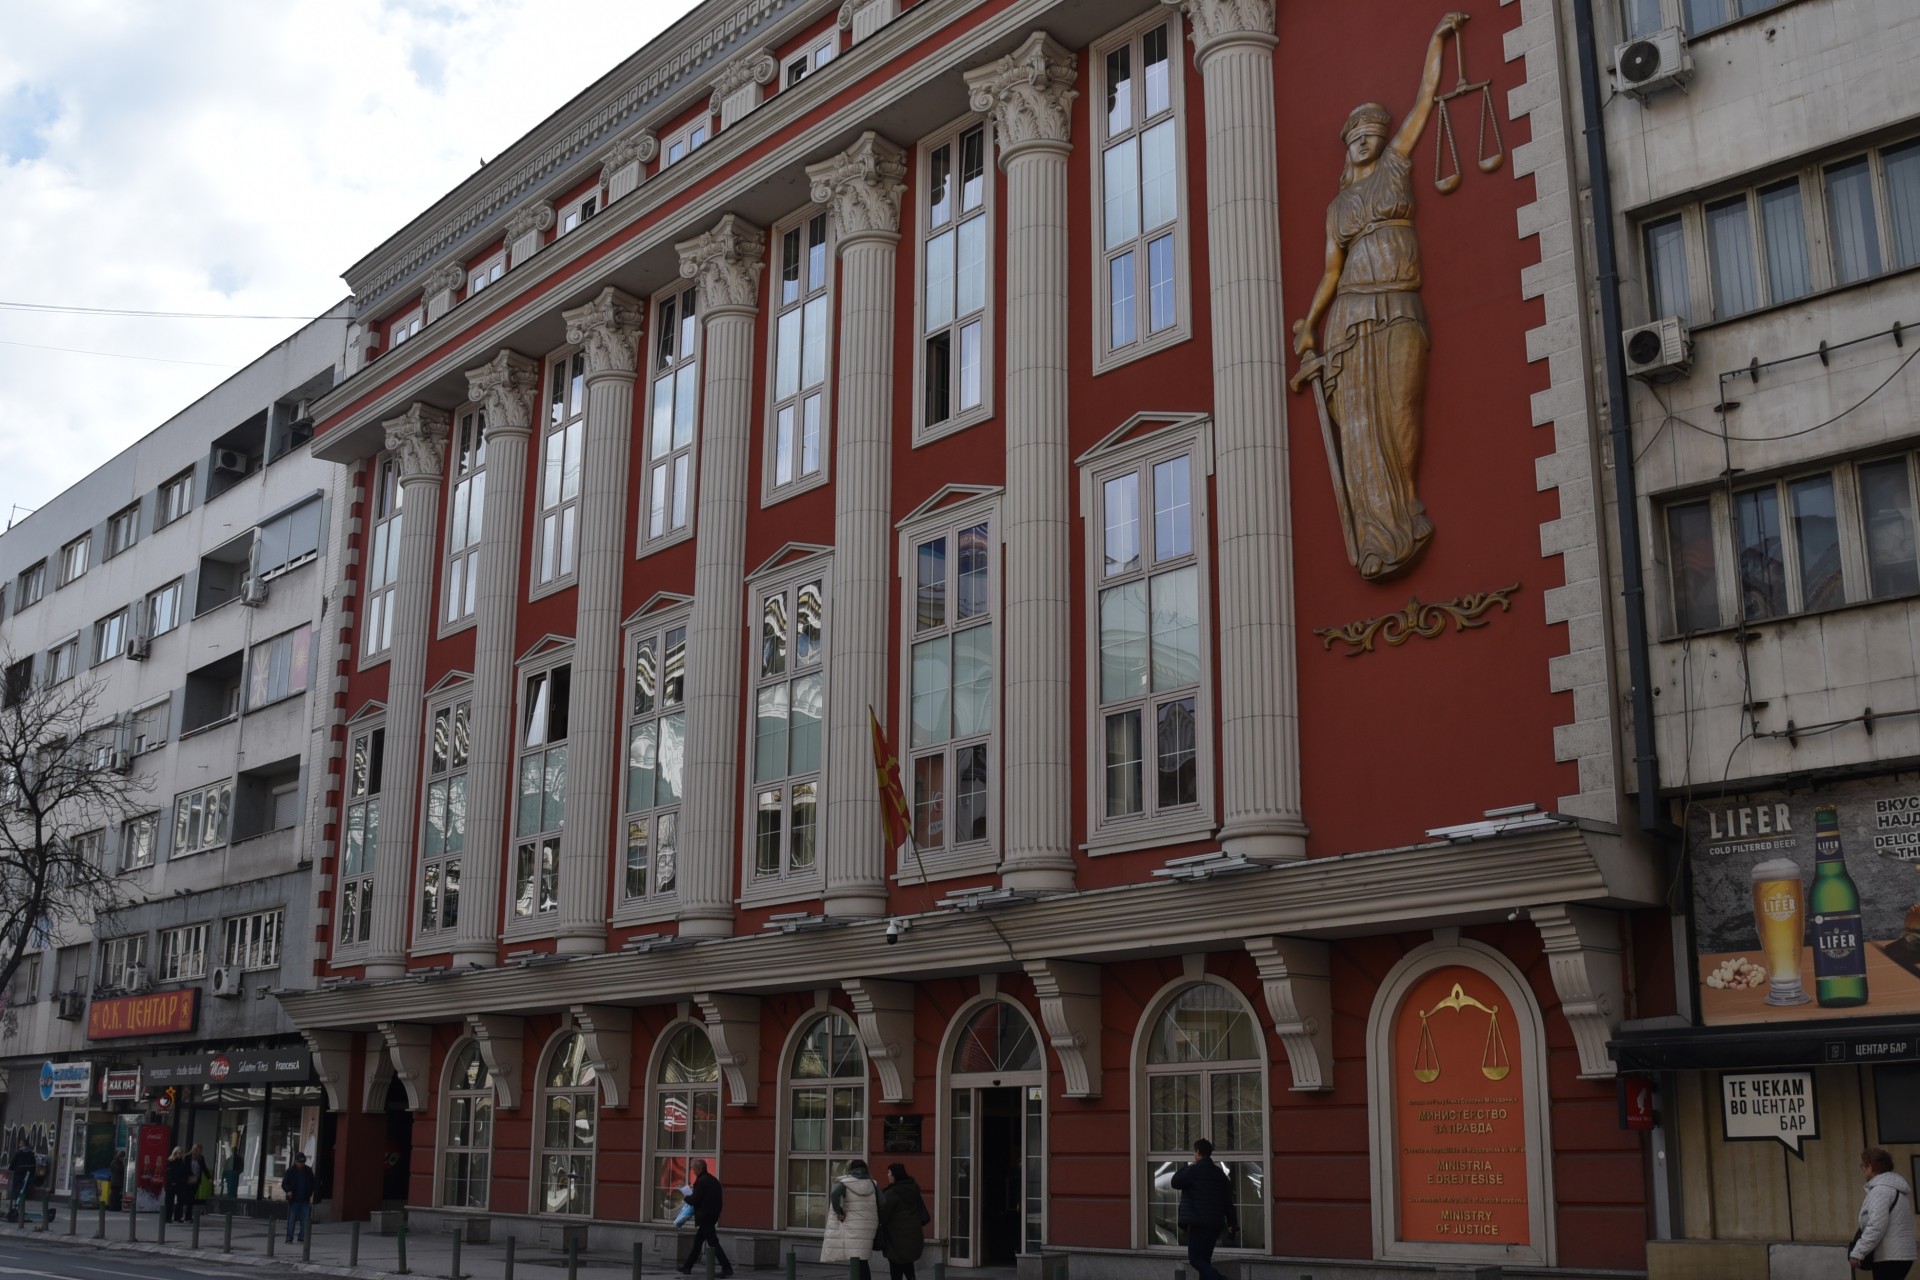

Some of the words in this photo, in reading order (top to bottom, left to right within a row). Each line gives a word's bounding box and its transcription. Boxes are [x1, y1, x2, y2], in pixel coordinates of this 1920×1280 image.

[1709, 803, 1792, 839] LIFER
[1709, 846, 1731, 855] COLD
[1732, 841, 1772, 853] FILTERED
[1773, 839, 1797, 849] BEER
[1817, 840, 1839, 851] LIFER
[1764, 898, 1795, 913] LIFER
[1819, 934, 1856, 949] LIFER
[1856, 1043, 1888, 1056] ЦЕНТАР
[1890, 1042, 1907, 1053] БАР
[1729, 1081, 1746, 1097] ТЕ
[1752, 1079, 1804, 1097] ЧЕКАМ
[1731, 1100, 1747, 1115] ВО
[1752, 1098, 1805, 1116] ЦЕНТАР
[1418, 1109, 1508, 1121] МИНИСТЕРСТВО
[1433, 1124, 1446, 1135] ЗА
[1450, 1122, 1493, 1135] ПРАВДА
[1780, 1115, 1806, 1131] БАР
[1437, 1160, 1492, 1171] MINISTRIA
[1427, 1175, 1434, 1184] E
[1436, 1172, 1504, 1184] DREJTËSISË
[1441, 1210, 1492, 1221] MINISTRY
[1436, 1224, 1450, 1234] OF
[1453, 1224, 1498, 1235] JUSTICE
